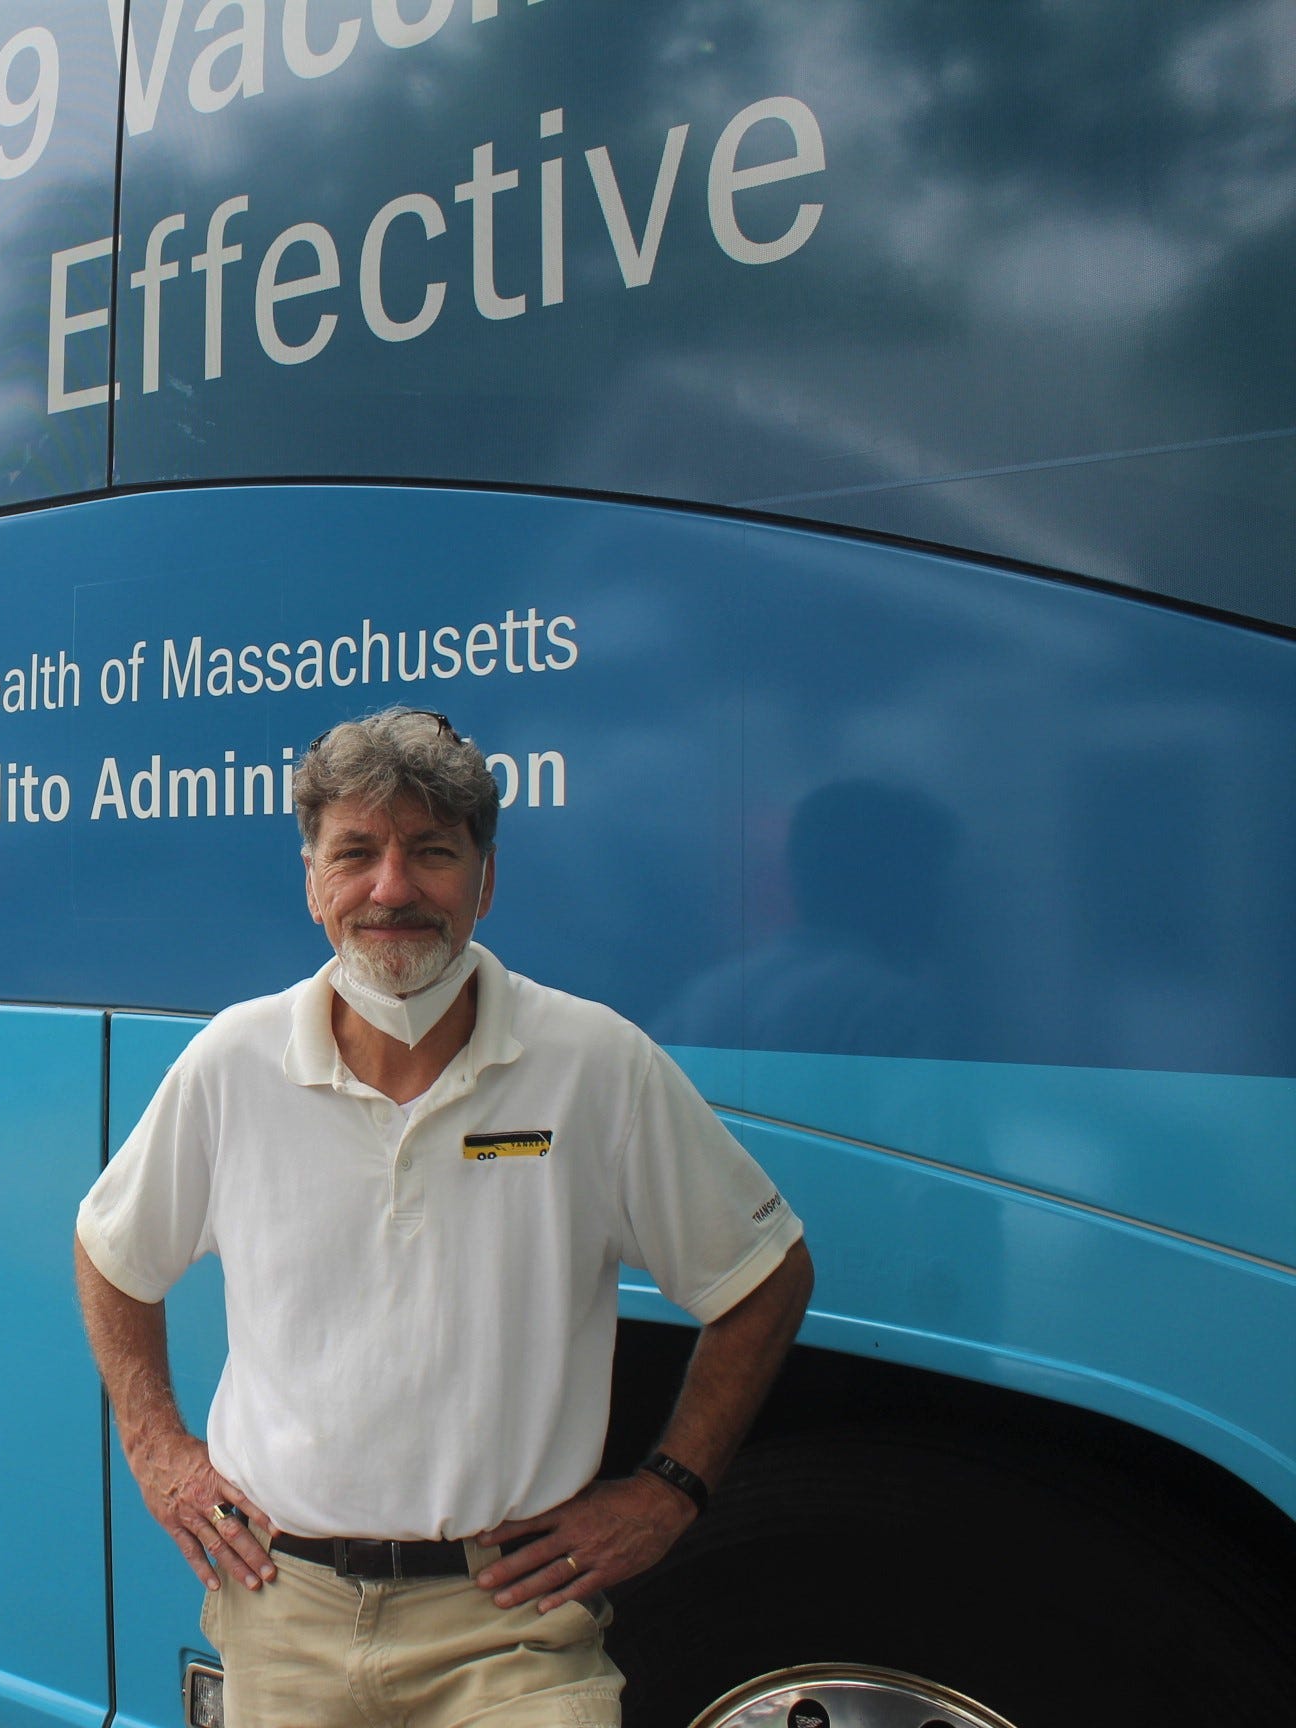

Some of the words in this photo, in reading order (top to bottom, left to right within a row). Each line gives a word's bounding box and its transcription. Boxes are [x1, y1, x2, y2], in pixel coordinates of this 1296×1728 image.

[108, 0, 545, 137] Vac
[47, 96, 826, 415] Effective
[101, 641, 147, 705] of
[162, 607, 578, 700] Massachusetts
[91, 738, 566, 821] Adminion
